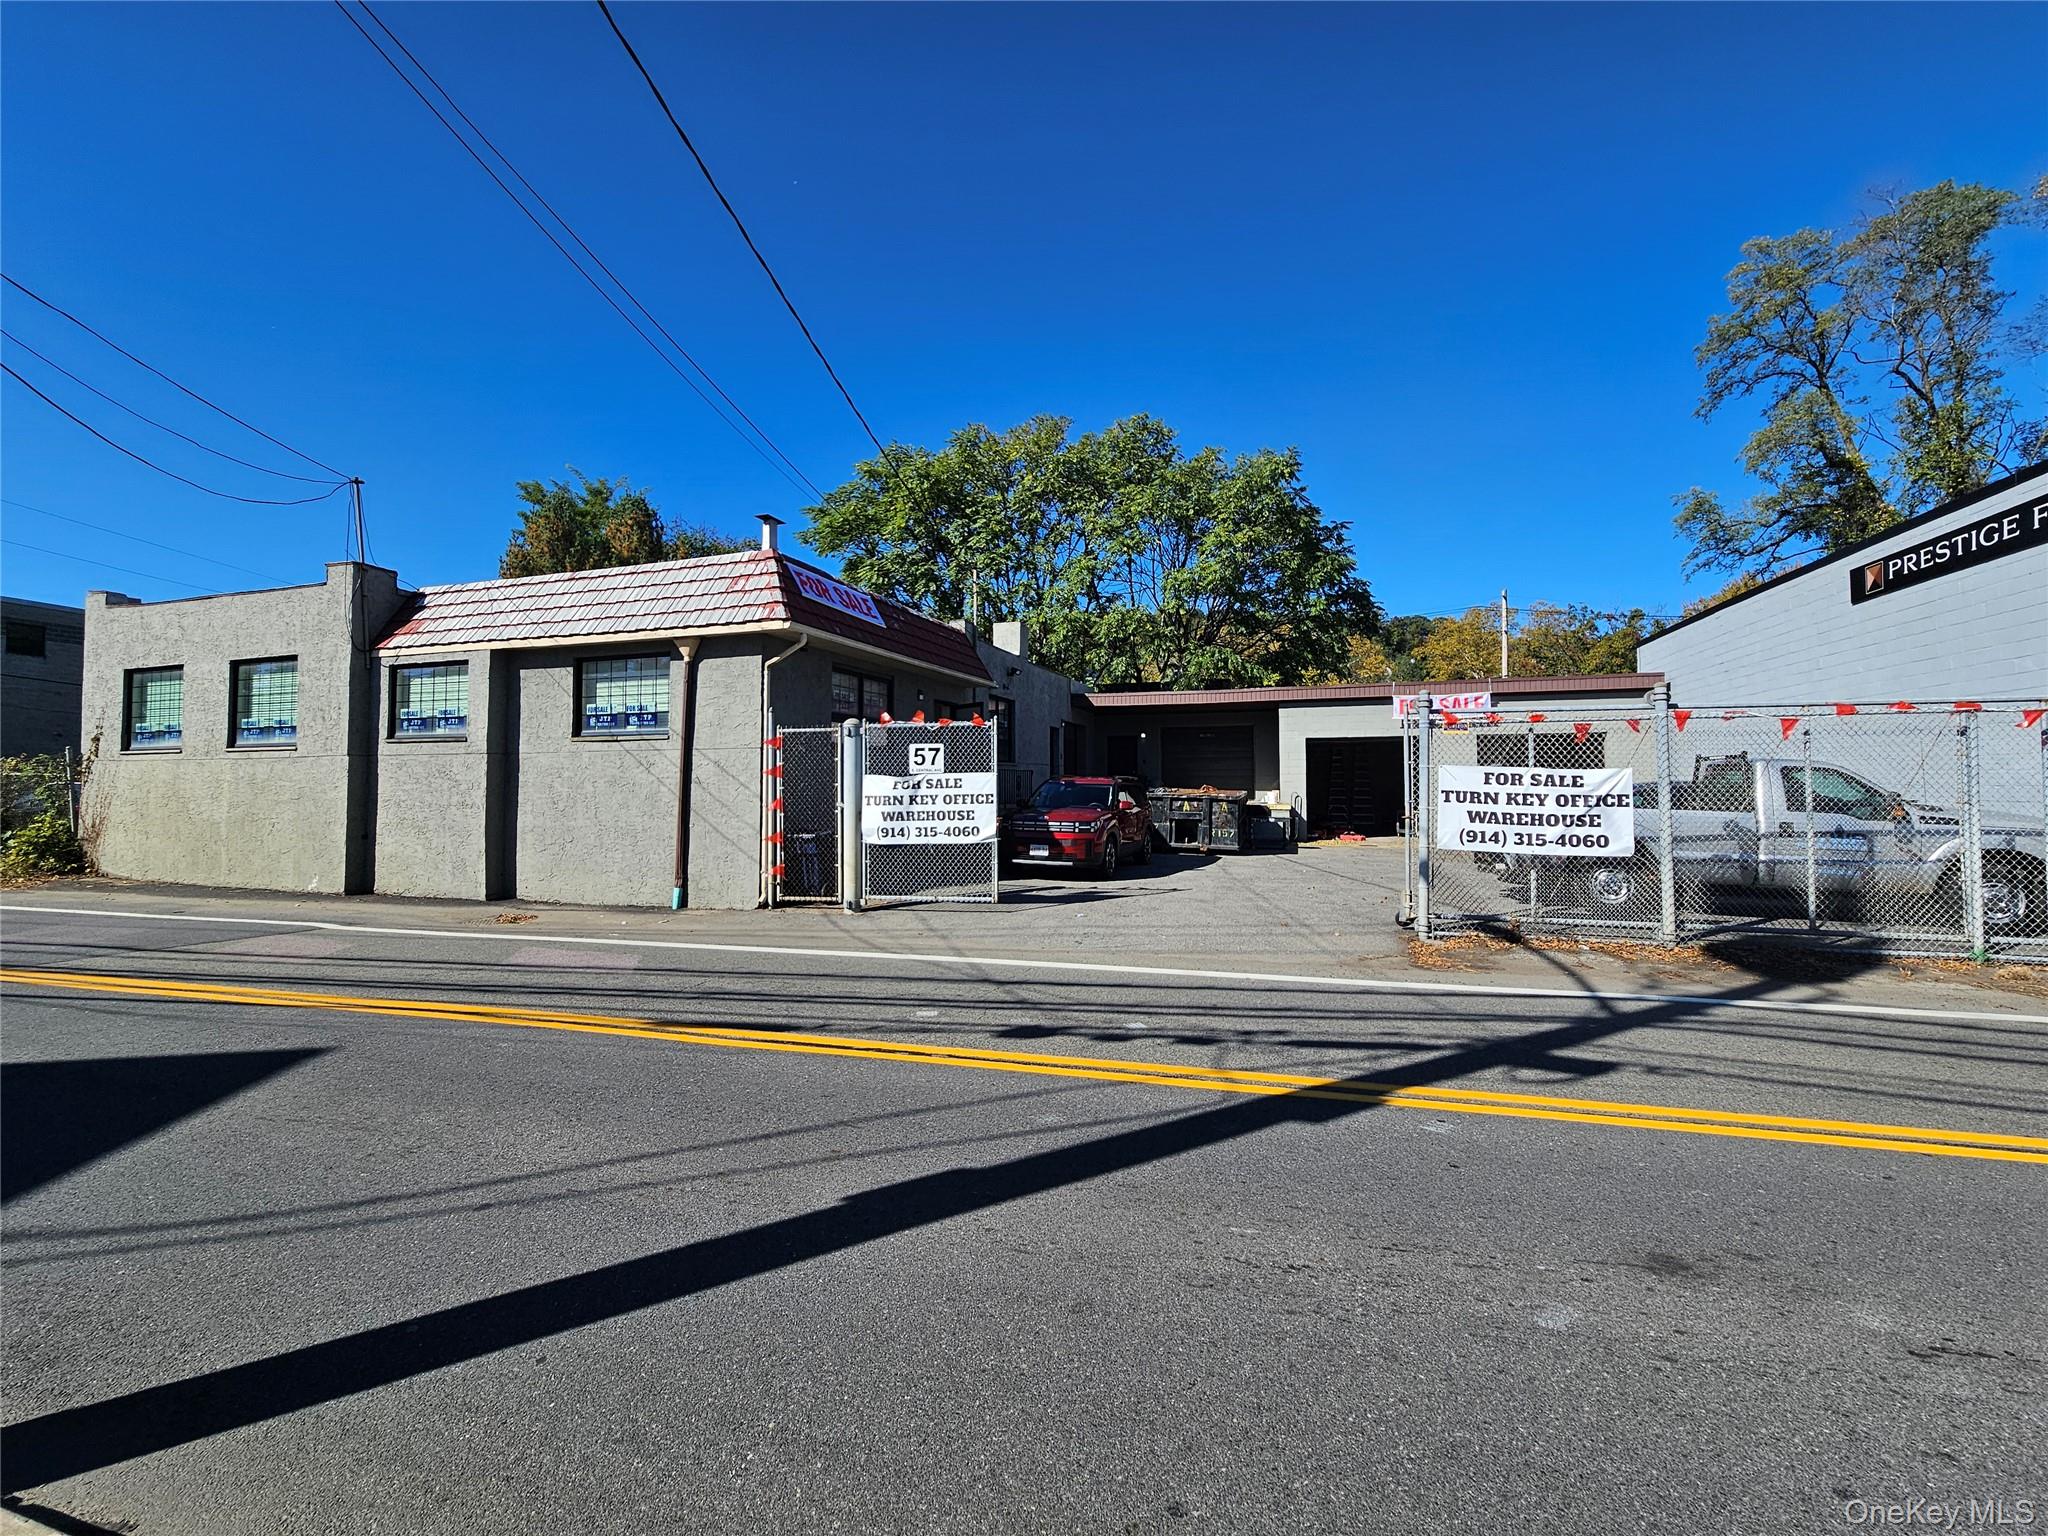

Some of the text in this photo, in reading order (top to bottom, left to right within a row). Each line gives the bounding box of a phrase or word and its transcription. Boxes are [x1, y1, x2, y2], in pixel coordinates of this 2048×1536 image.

[1888, 514, 2020, 580] PRESTIGE
[792, 570, 880, 620] FOR SALE
[913, 747, 941, 766] 57
[892, 778, 963, 790] FOR SALE
[1483, 772, 1585, 788] FOR SALE
[865, 793, 994, 806] TURN KEY OFFICE
[1441, 789, 1630, 808] TURN KEY OFFICE
[881, 810, 975, 822] WAREHOUSE
[1467, 810, 1602, 828] WAREHOUSE
[876, 825, 980, 840] (914) 315-4060
[1459, 828, 1610, 848] (914) 315-4060
